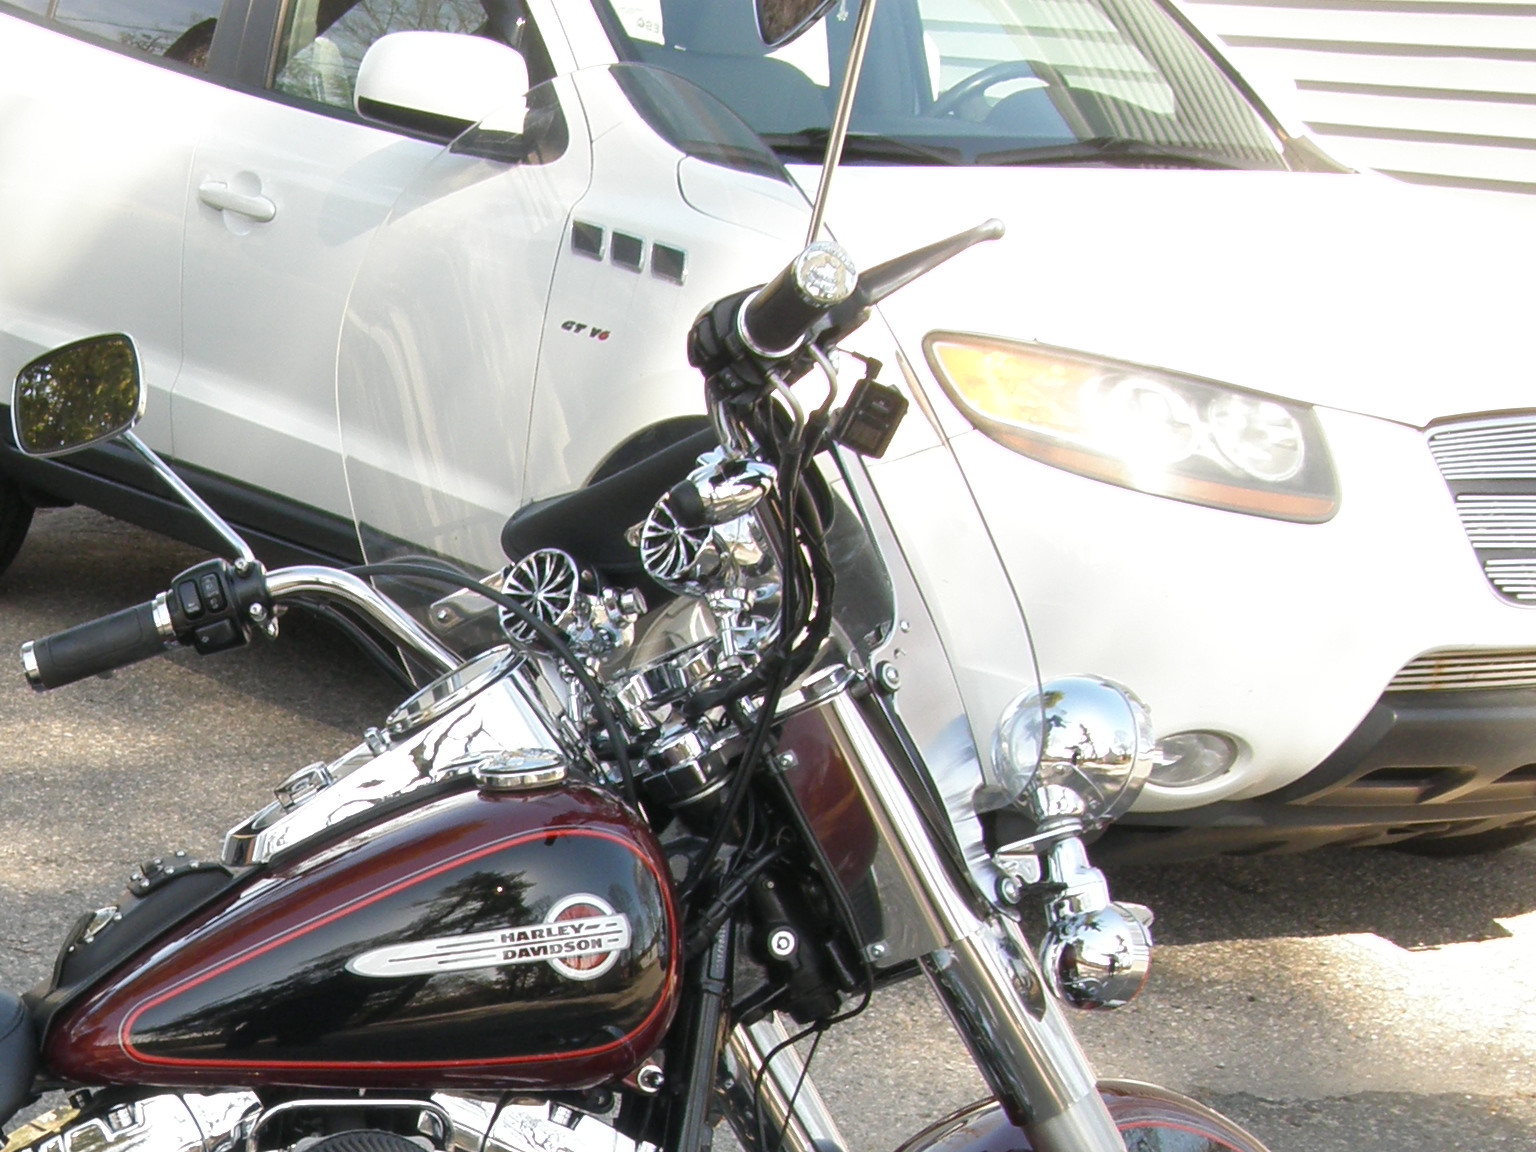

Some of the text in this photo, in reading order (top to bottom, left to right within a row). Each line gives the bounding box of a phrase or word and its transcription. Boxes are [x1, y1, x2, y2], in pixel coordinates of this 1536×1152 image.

[560, 319, 611, 341] GT V6
[501, 937, 603, 961] DAVIDSON
